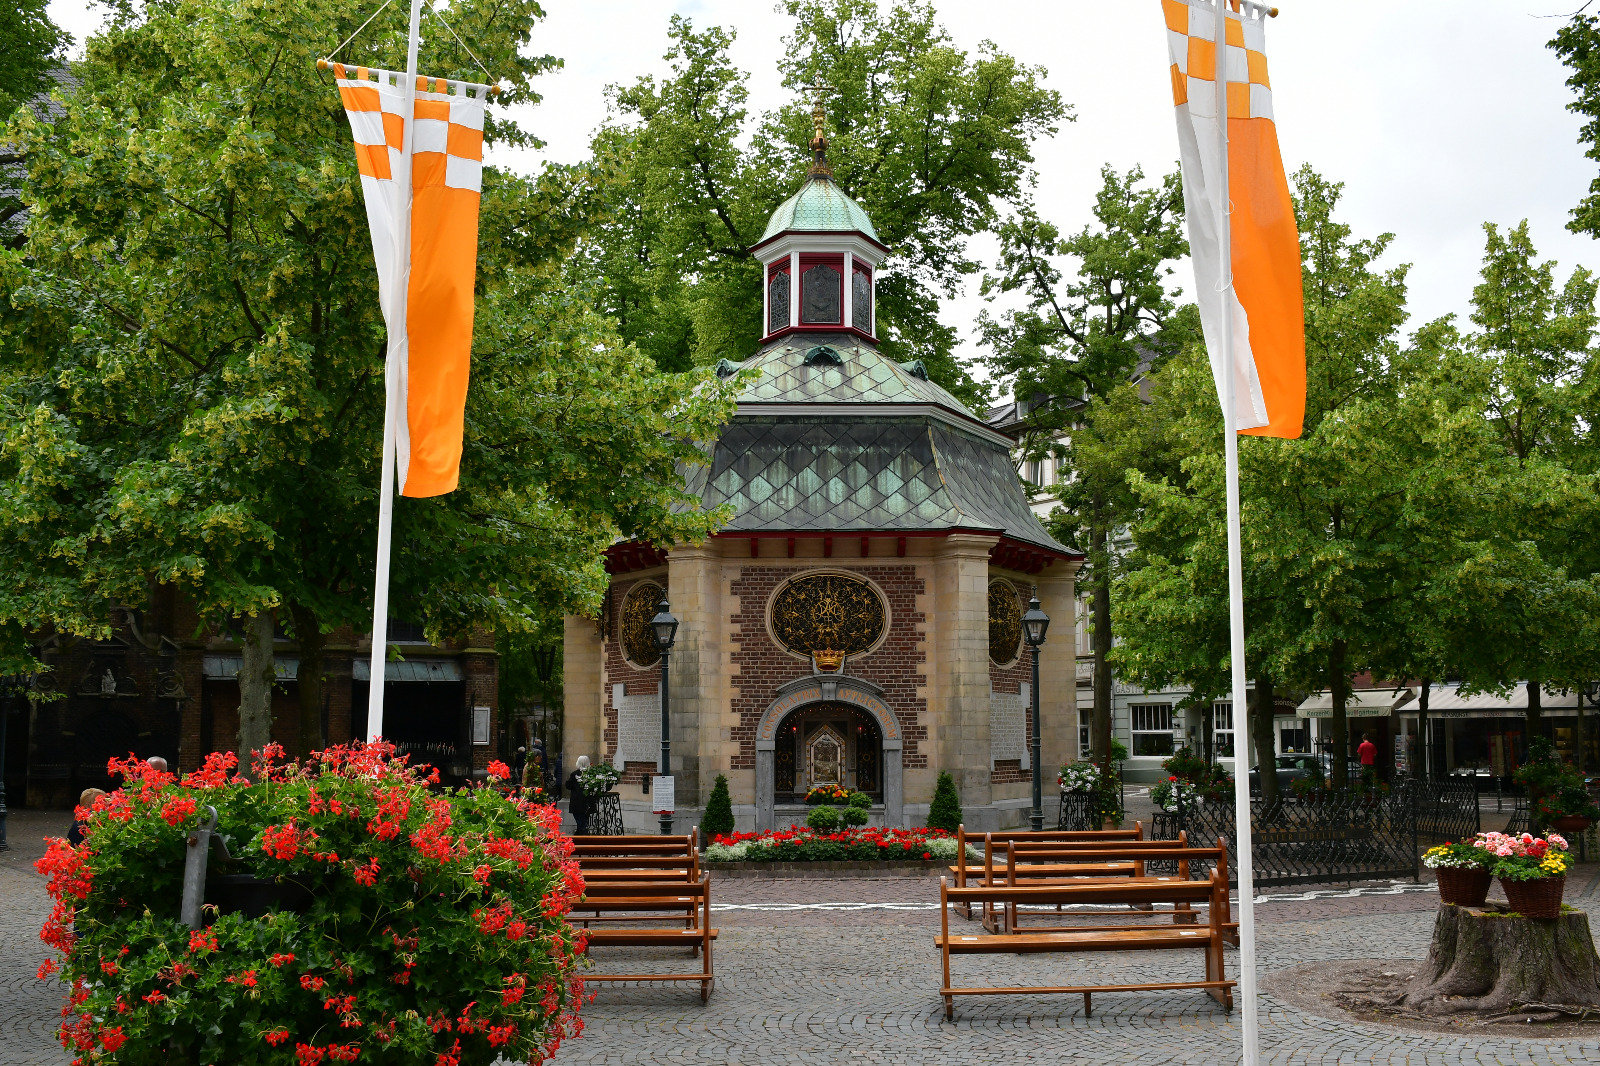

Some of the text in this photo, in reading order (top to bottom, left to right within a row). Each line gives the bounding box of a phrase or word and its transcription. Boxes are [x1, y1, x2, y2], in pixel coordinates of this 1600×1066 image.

[762, 687, 897, 739] CONSOLATRIX AFFLICTORUM
[1261, 833, 1293, 842] MATER
